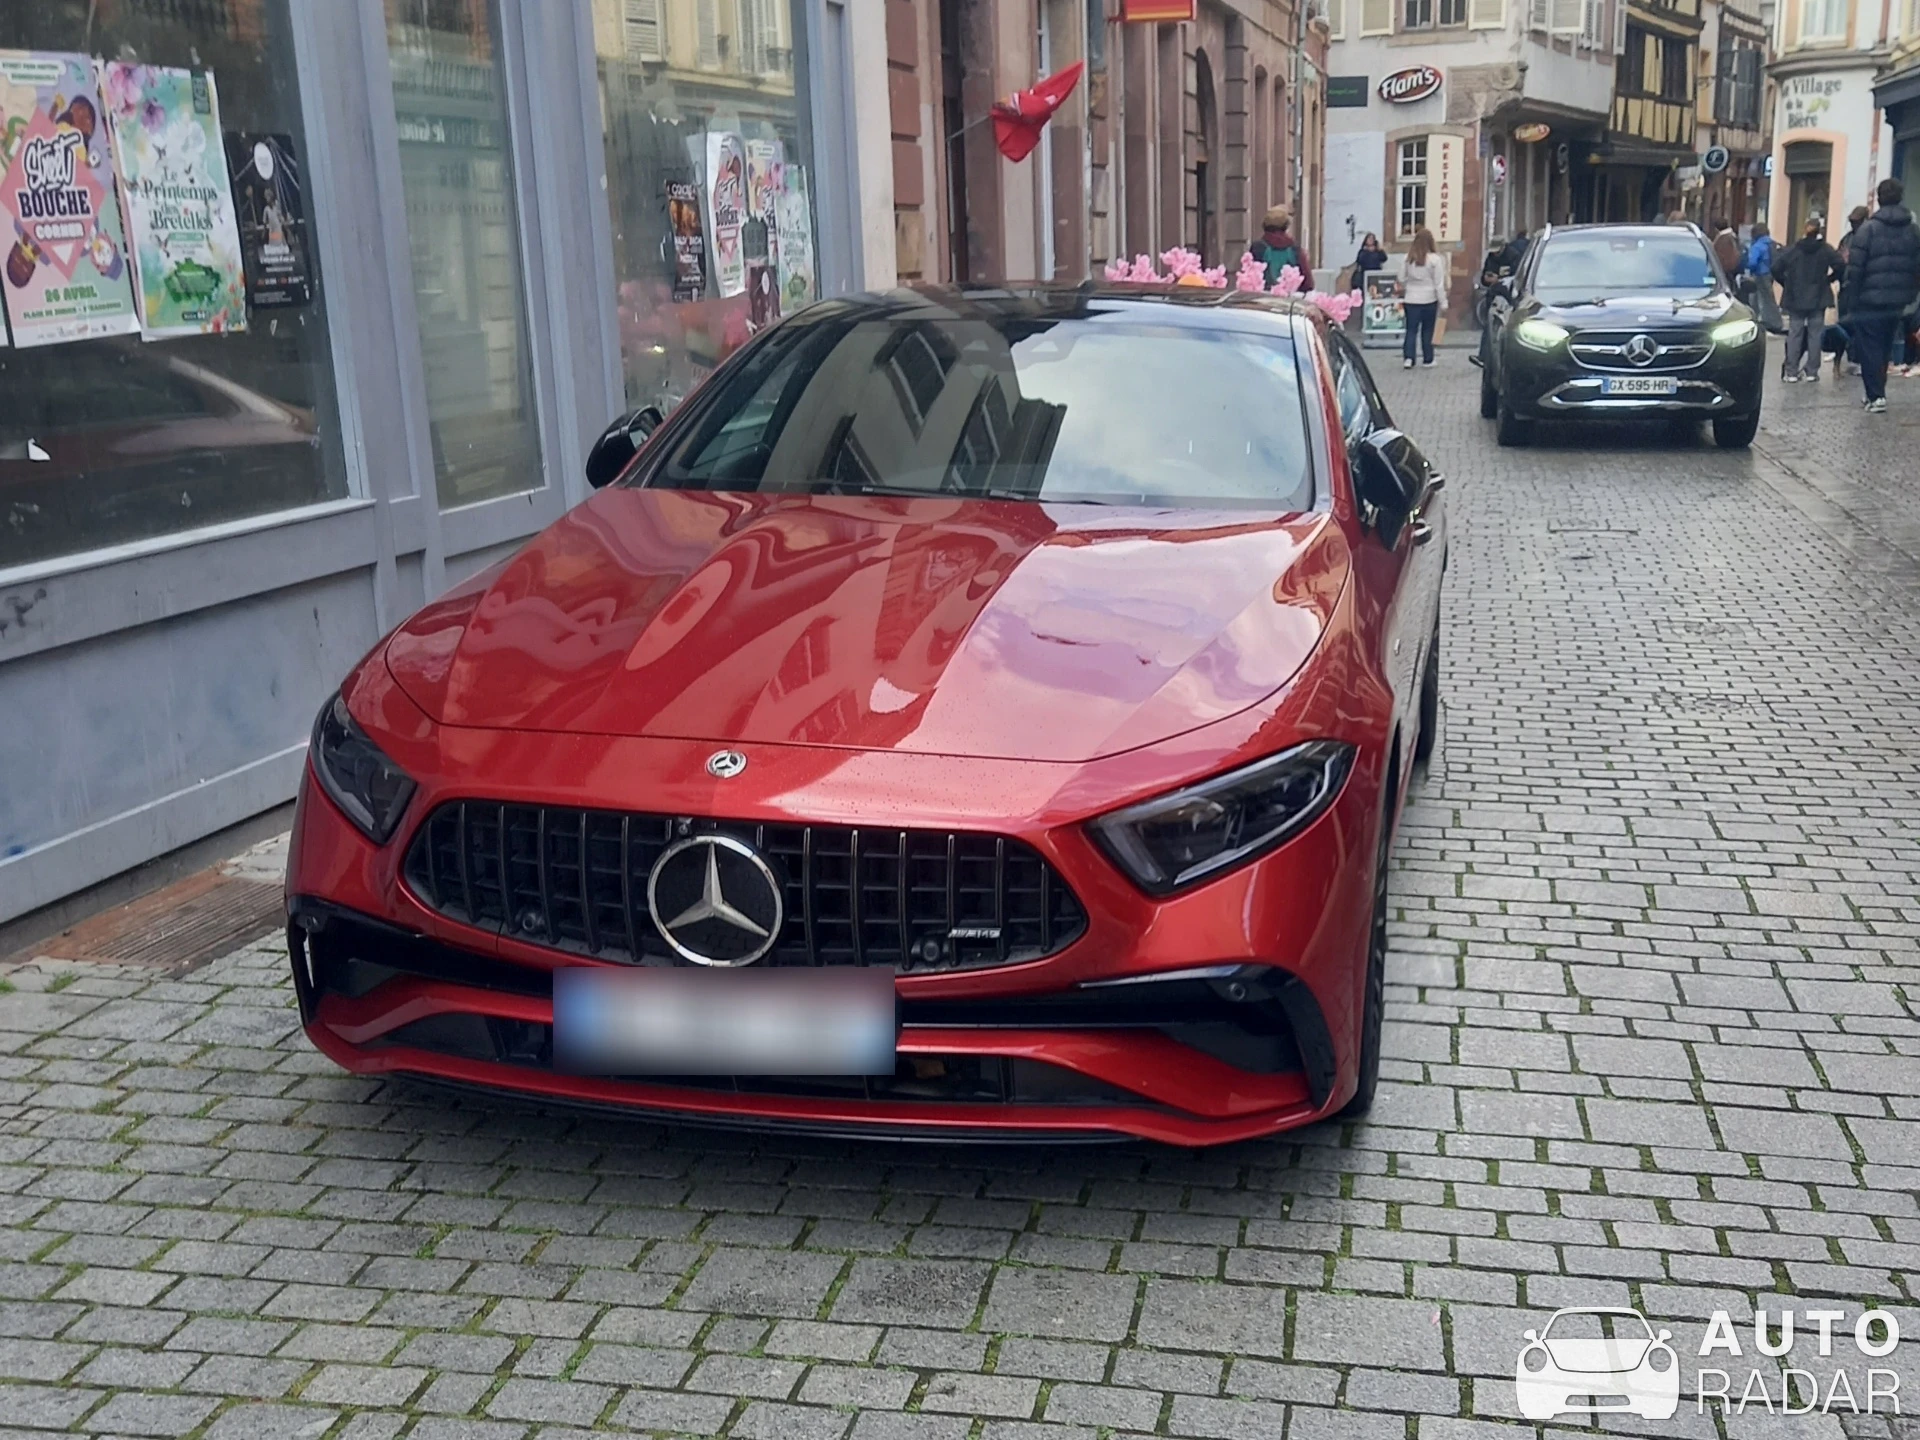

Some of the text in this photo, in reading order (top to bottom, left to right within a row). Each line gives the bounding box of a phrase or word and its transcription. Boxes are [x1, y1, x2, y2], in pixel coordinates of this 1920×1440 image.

[1381, 67, 1435, 99] Flam's
[1793, 77, 1842, 96] Village
[18, 189, 91, 218] BOUCHE
[142, 179, 218, 206] Printemps
[1440, 142, 1450, 239] RESTAURANT
[149, 210, 213, 230] Bretelles
[63, 285, 98, 301] AVRIL
